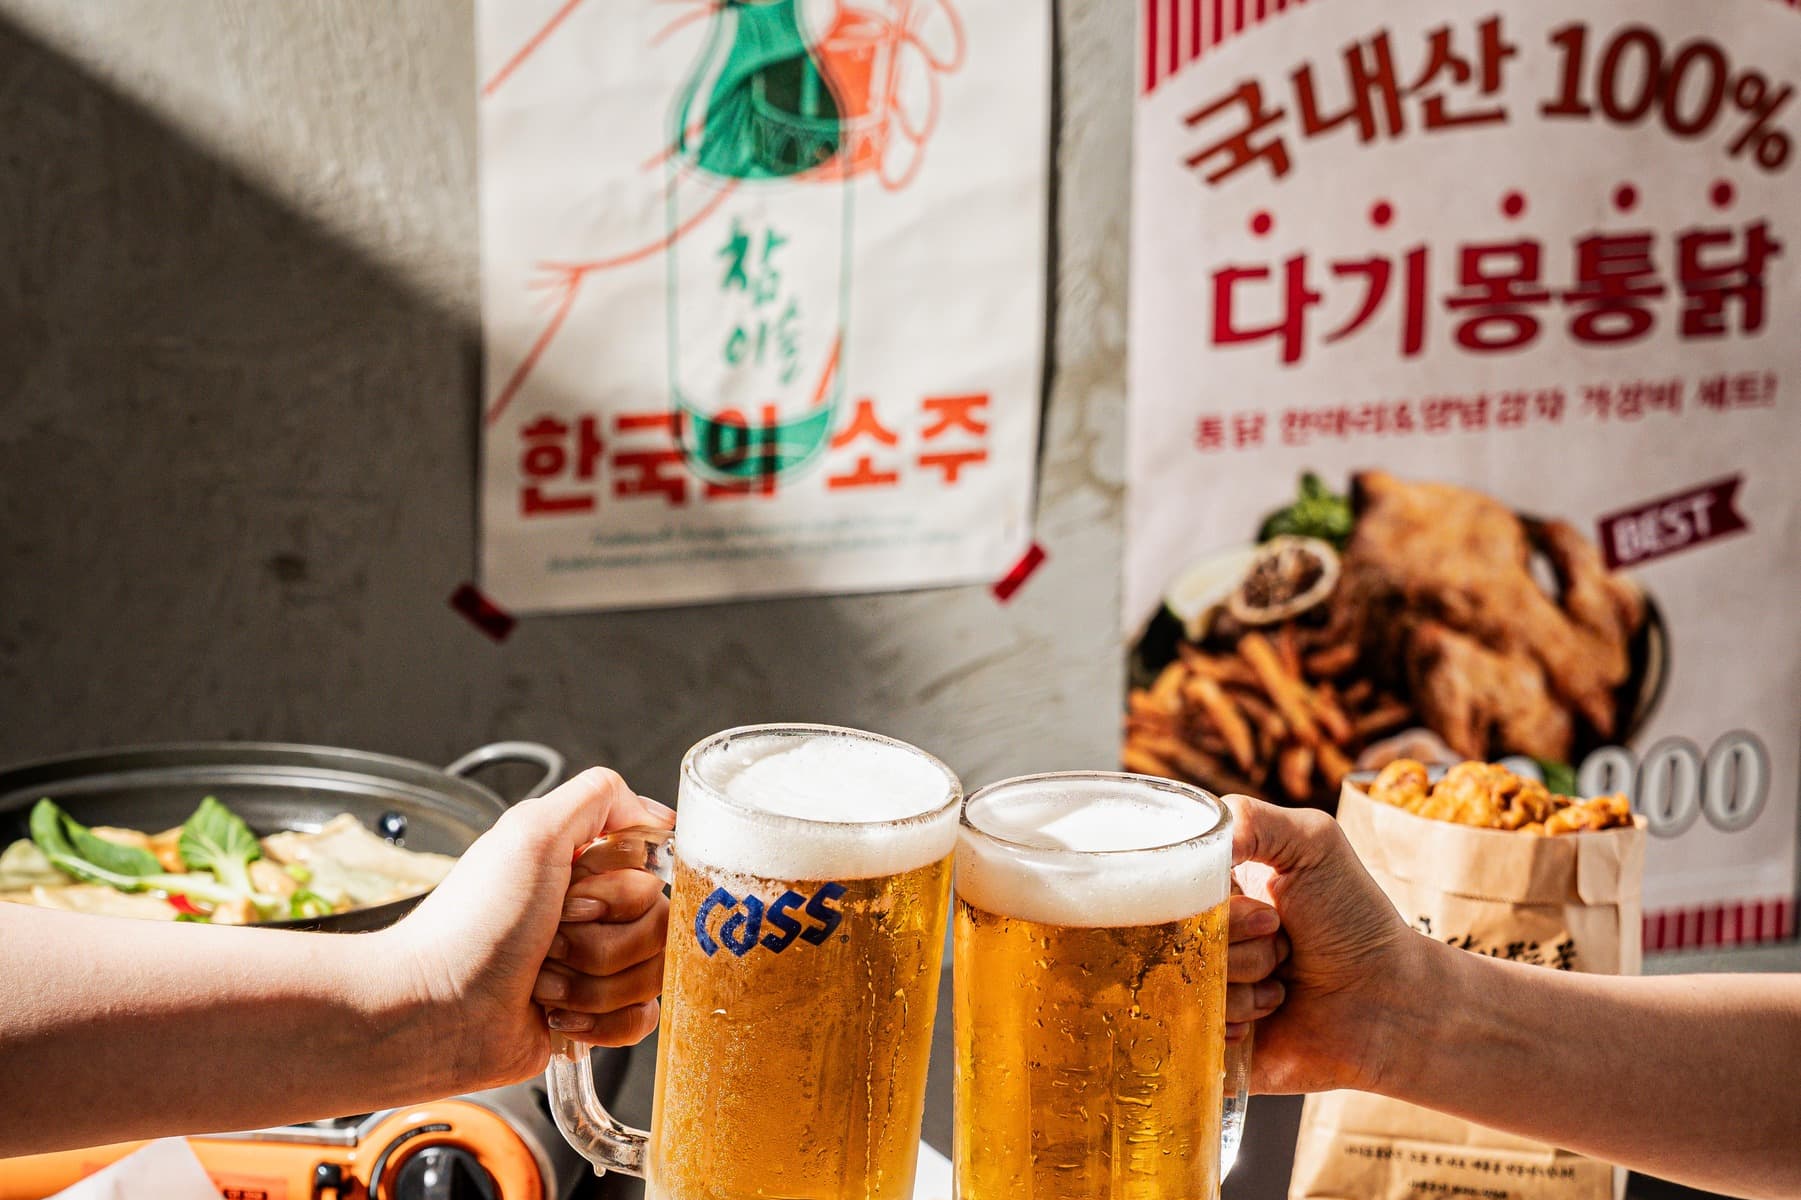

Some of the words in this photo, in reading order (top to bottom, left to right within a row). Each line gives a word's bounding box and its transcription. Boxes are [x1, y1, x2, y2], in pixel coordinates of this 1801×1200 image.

[1183, 15, 1518, 186] 국내산
[1539, 21, 1794, 172] 100%
[1209, 218, 1783, 367] 다기몽통닭
[519, 404, 778, 518] 한국의
[825, 394, 990, 490] 소주
[1612, 494, 1716, 562] BEST
